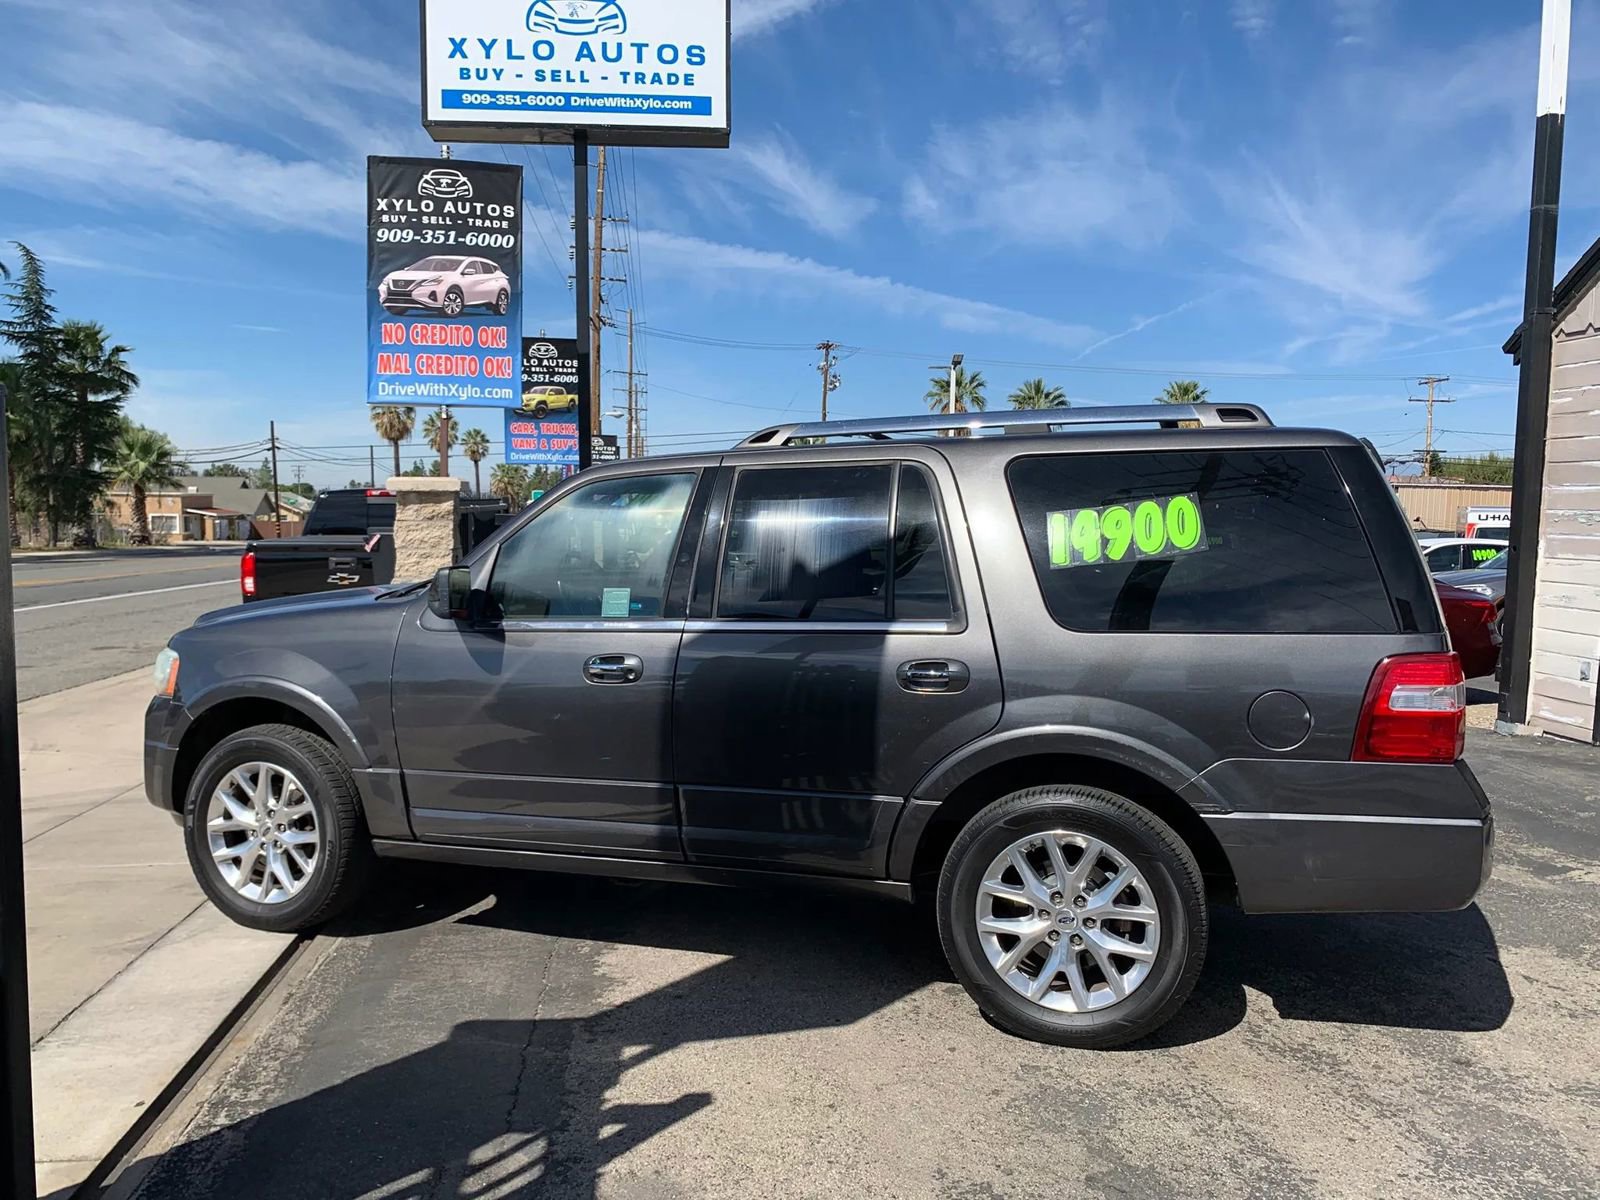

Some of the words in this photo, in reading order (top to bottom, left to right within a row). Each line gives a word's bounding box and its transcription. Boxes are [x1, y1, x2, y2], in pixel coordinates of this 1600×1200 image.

[448, 37, 555, 61] XYLO
[575, 41, 706, 66] AUTOS
[459, 67, 505, 81] BUY
[535, 69, 590, 83] SELL
[619, 71, 695, 86] TRADE
[462, 93, 565, 107] 909-351-6000
[570, 96, 692, 110] DriveWithXylo.com
[376, 198, 434, 212] XYLO
[443, 201, 515, 218] AUTOS
[381, 215, 407, 223] BUY
[422, 216, 452, 224] SELL
[467, 218, 509, 228] TRADE
[376, 228, 515, 249] 909-351-6000
[382, 323, 406, 345] NO
[410, 323, 474, 347] CREDITO
[478, 326, 507, 349] OK!
[377, 352, 411, 375] MAL
[415, 354, 479, 377] CREDITO
[483, 355, 513, 378] OK!
[523, 358, 538, 366] LO
[521, 373, 579, 383] 9-351-6000
[378, 381, 513, 400] DriveWithXylo.com
[510, 422, 538, 436] CARS,
[540, 422, 579, 437] TRUCKS,
[512, 437, 537, 450] VANS
[540, 438, 548, 449] &
[510, 452, 580, 462] DriveWithXylo.com
[1050, 496, 1201, 566] 14900
